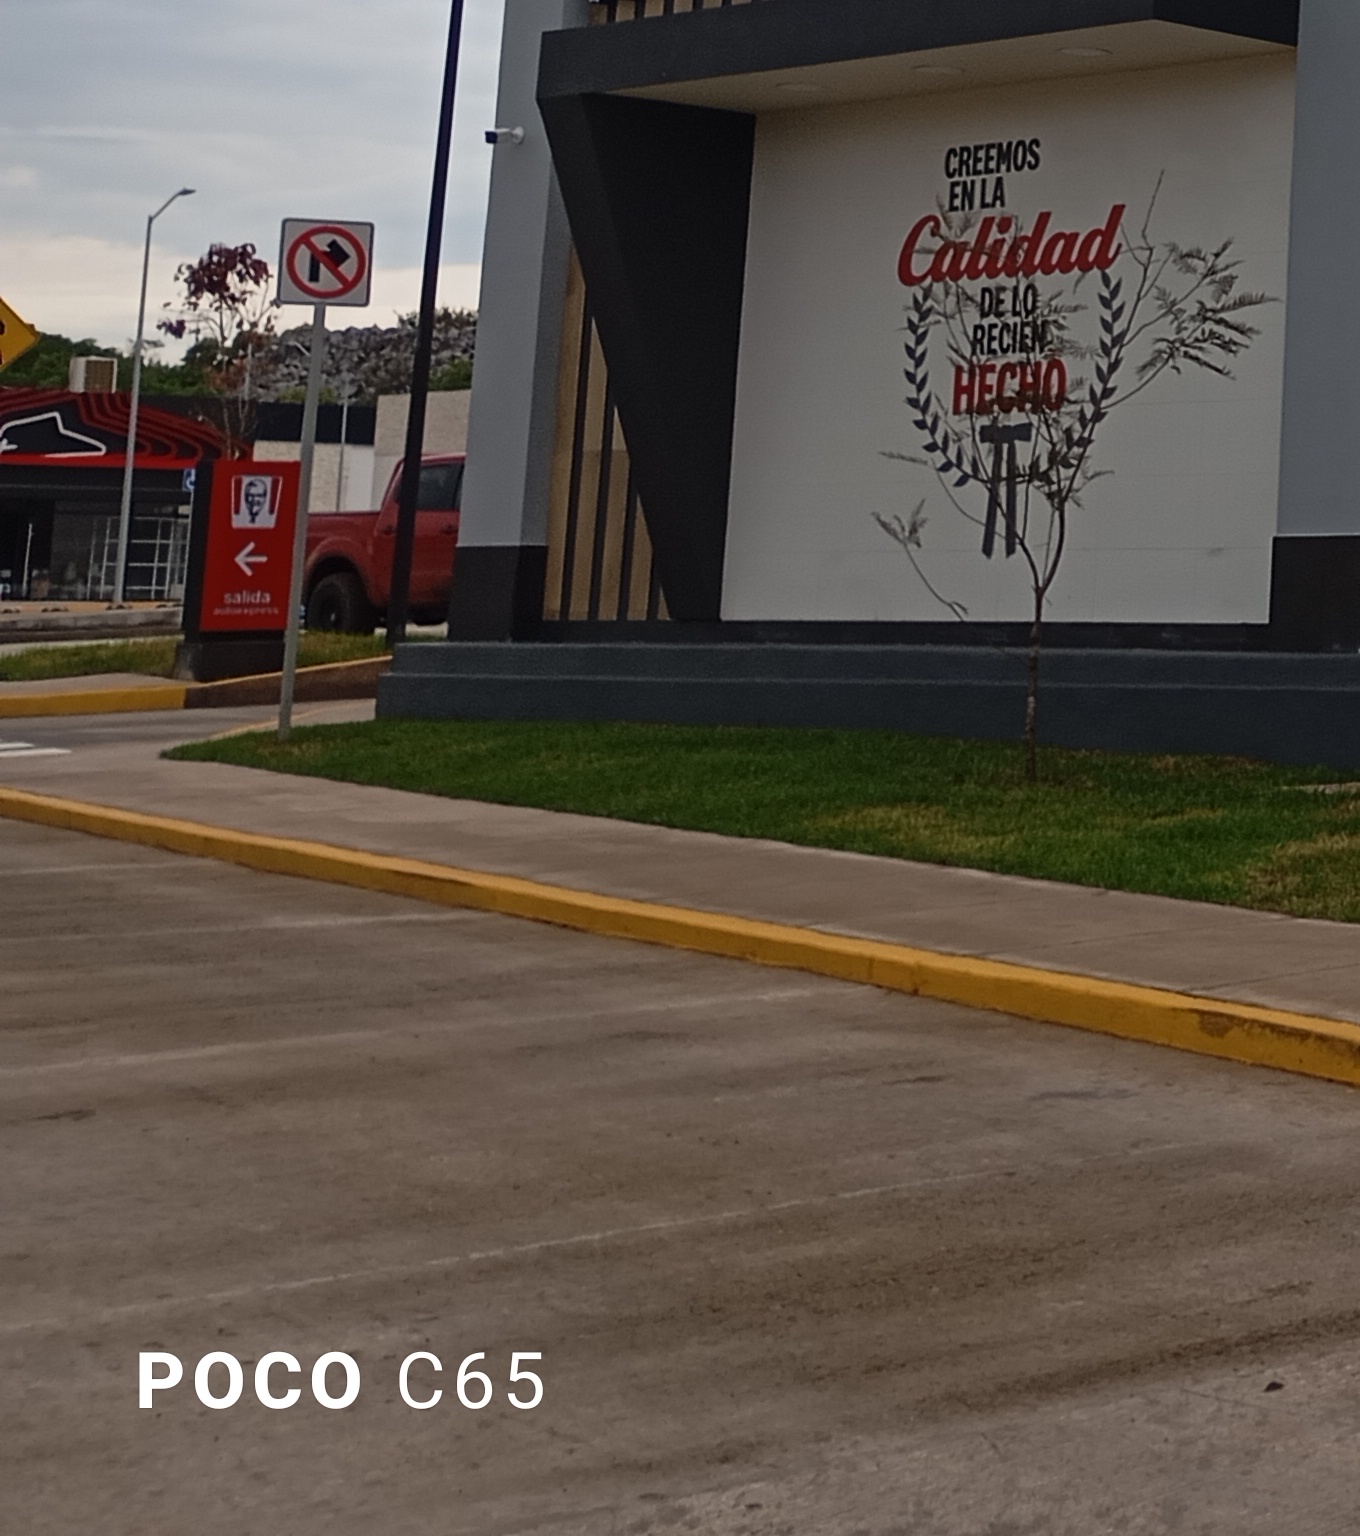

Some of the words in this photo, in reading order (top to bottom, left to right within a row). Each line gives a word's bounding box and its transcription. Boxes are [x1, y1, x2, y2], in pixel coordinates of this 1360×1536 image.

[944, 138, 1041, 179] CREEMOS
[948, 179, 975, 212] EN
[980, 176, 1005, 209] LA
[897, 203, 1126, 287] Calidad
[980, 286, 1005, 320] DE
[1011, 282, 1039, 317] LO
[953, 356, 1067, 415] HECHO
[223, 590, 271, 604] salida
